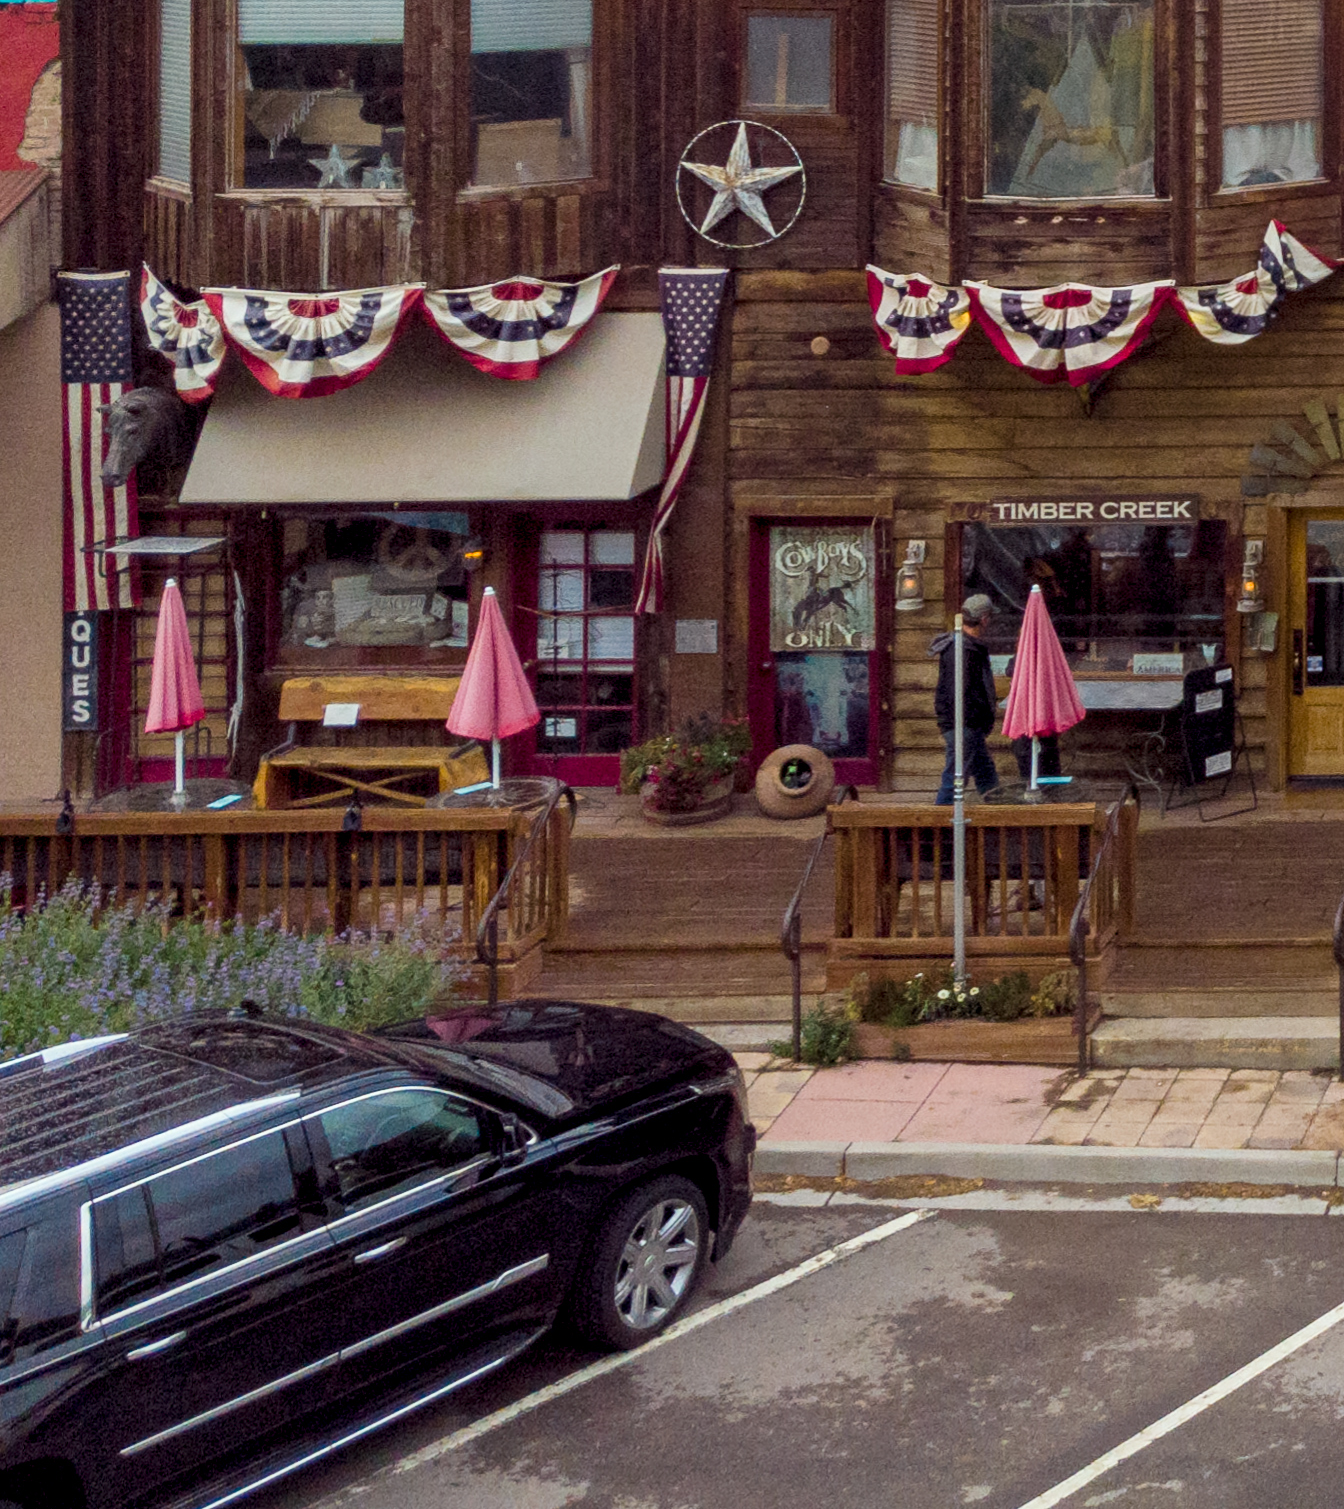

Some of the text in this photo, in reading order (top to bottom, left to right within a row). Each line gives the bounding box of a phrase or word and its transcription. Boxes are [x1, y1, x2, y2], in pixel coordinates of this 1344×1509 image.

[994, 501, 1192, 520] TIMBER CREEK
[71, 611, 91, 723] QUES
